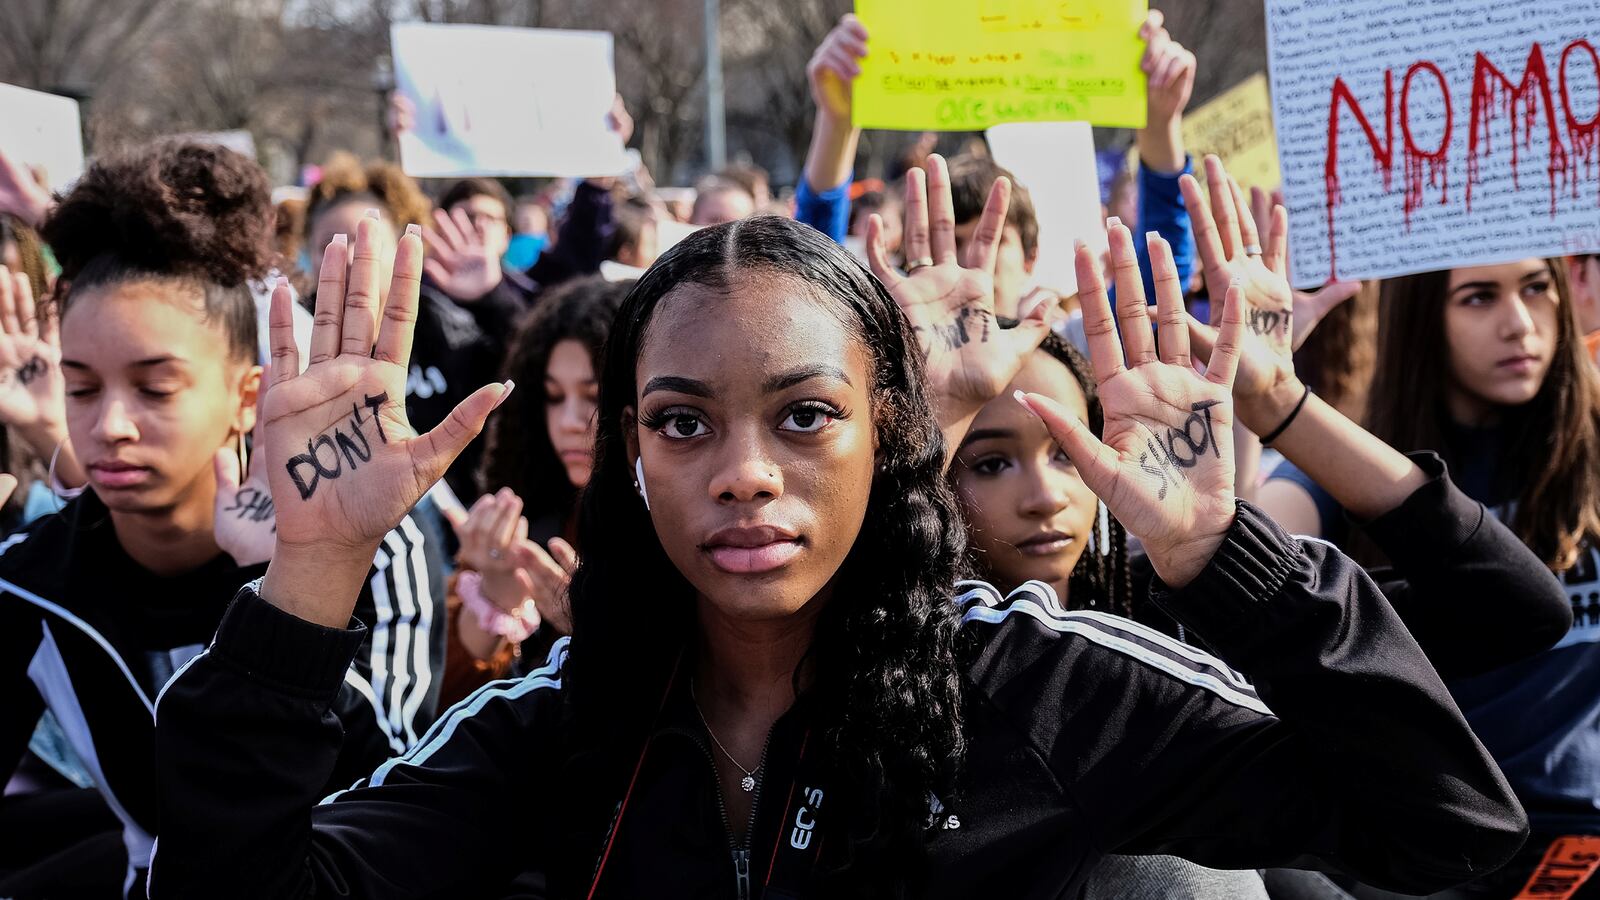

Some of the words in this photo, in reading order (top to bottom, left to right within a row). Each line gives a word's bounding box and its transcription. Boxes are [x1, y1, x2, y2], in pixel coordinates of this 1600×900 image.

[1324, 60, 1454, 180] NO
[286, 391, 389, 501] DON'T
[1139, 399, 1224, 501] SHOOT
